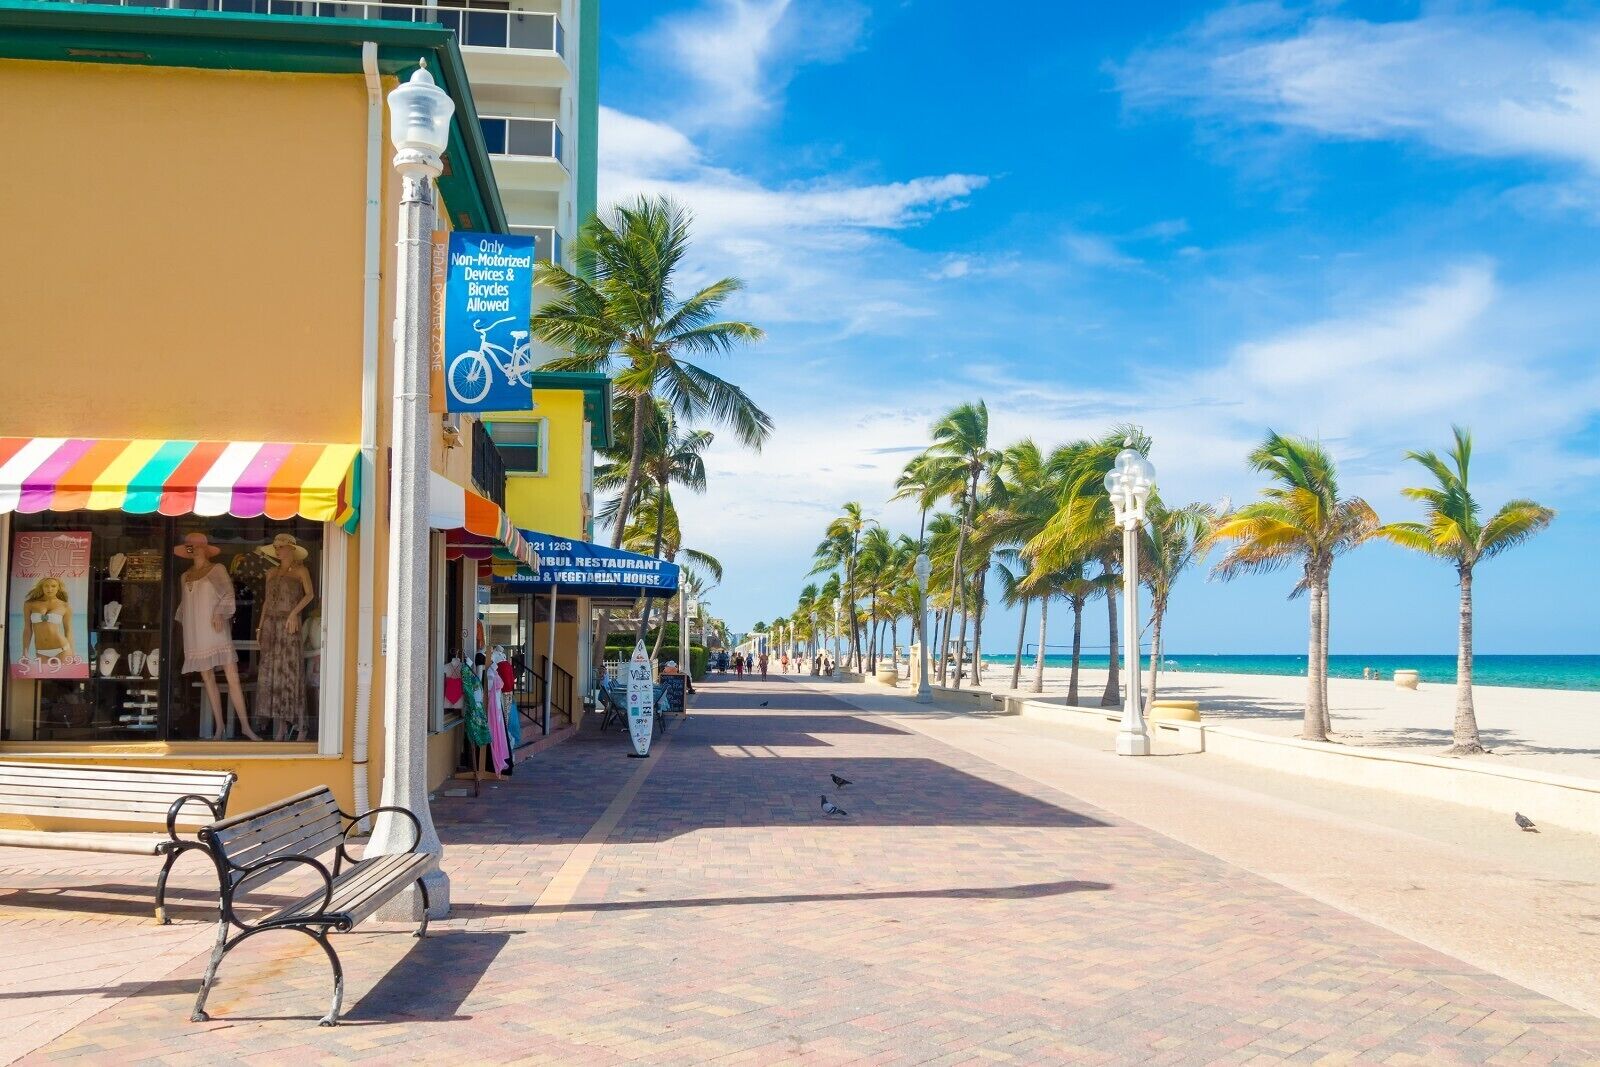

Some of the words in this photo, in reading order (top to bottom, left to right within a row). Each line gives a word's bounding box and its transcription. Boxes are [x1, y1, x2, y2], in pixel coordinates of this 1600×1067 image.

[480, 239, 504, 255] Only
[432, 243, 445, 280] PEDAL
[451, 252, 531, 268] Non-Motorized
[464, 267, 504, 281] Devices
[505, 268, 515, 282] &
[468, 282, 509, 298] Bicycles
[432, 283, 443, 331] POWER
[466, 297, 510, 312] Allowed
[432, 334, 442, 371] ZONE
[20, 536, 88, 549] SPECIAL
[549, 541, 572, 551] 1263
[18, 549, 86, 567] SALE
[576, 557, 662, 570] RESTAURANT
[543, 572, 552, 582] &
[553, 571, 620, 583] VEGETARIAN
[623, 573, 660, 585] HOUSE
